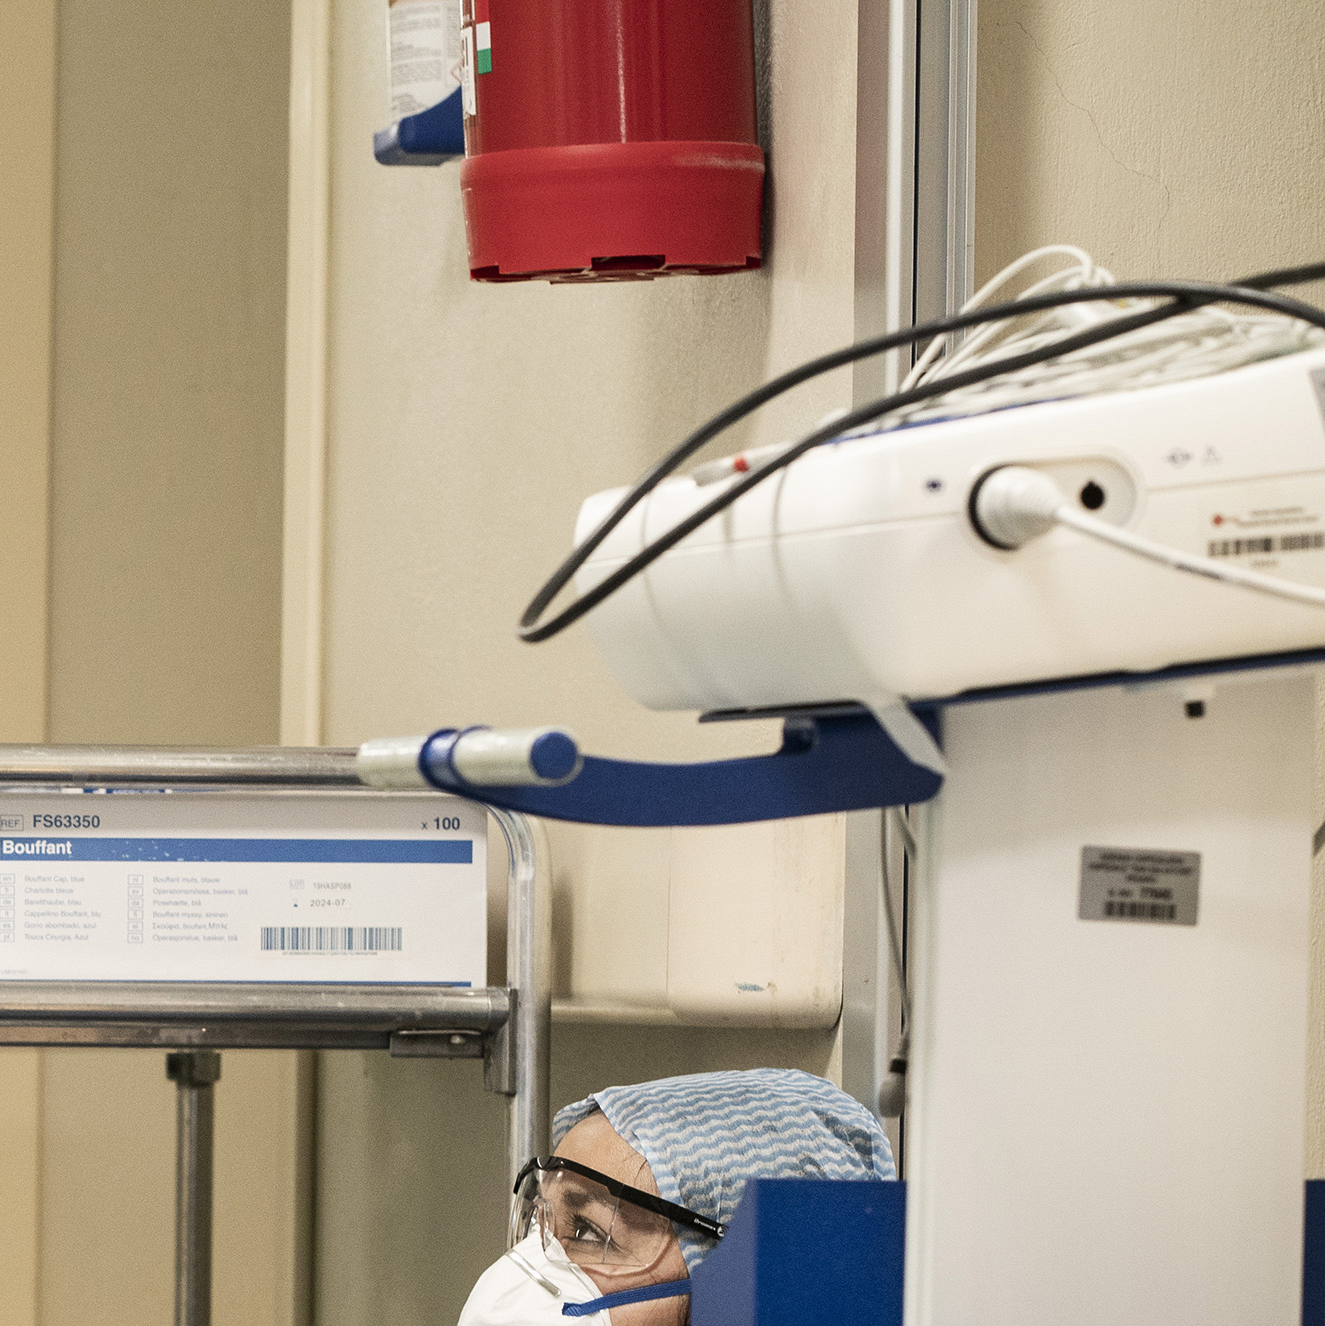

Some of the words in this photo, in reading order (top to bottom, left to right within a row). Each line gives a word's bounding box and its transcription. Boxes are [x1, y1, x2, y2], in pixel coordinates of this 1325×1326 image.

[1, 820, 20, 828] REF
[33, 814, 100, 829] FS63350
[434, 816, 460, 830] 100
[2, 840, 72, 855] Bouffant
[310, 898, 345, 907] 2024-07
